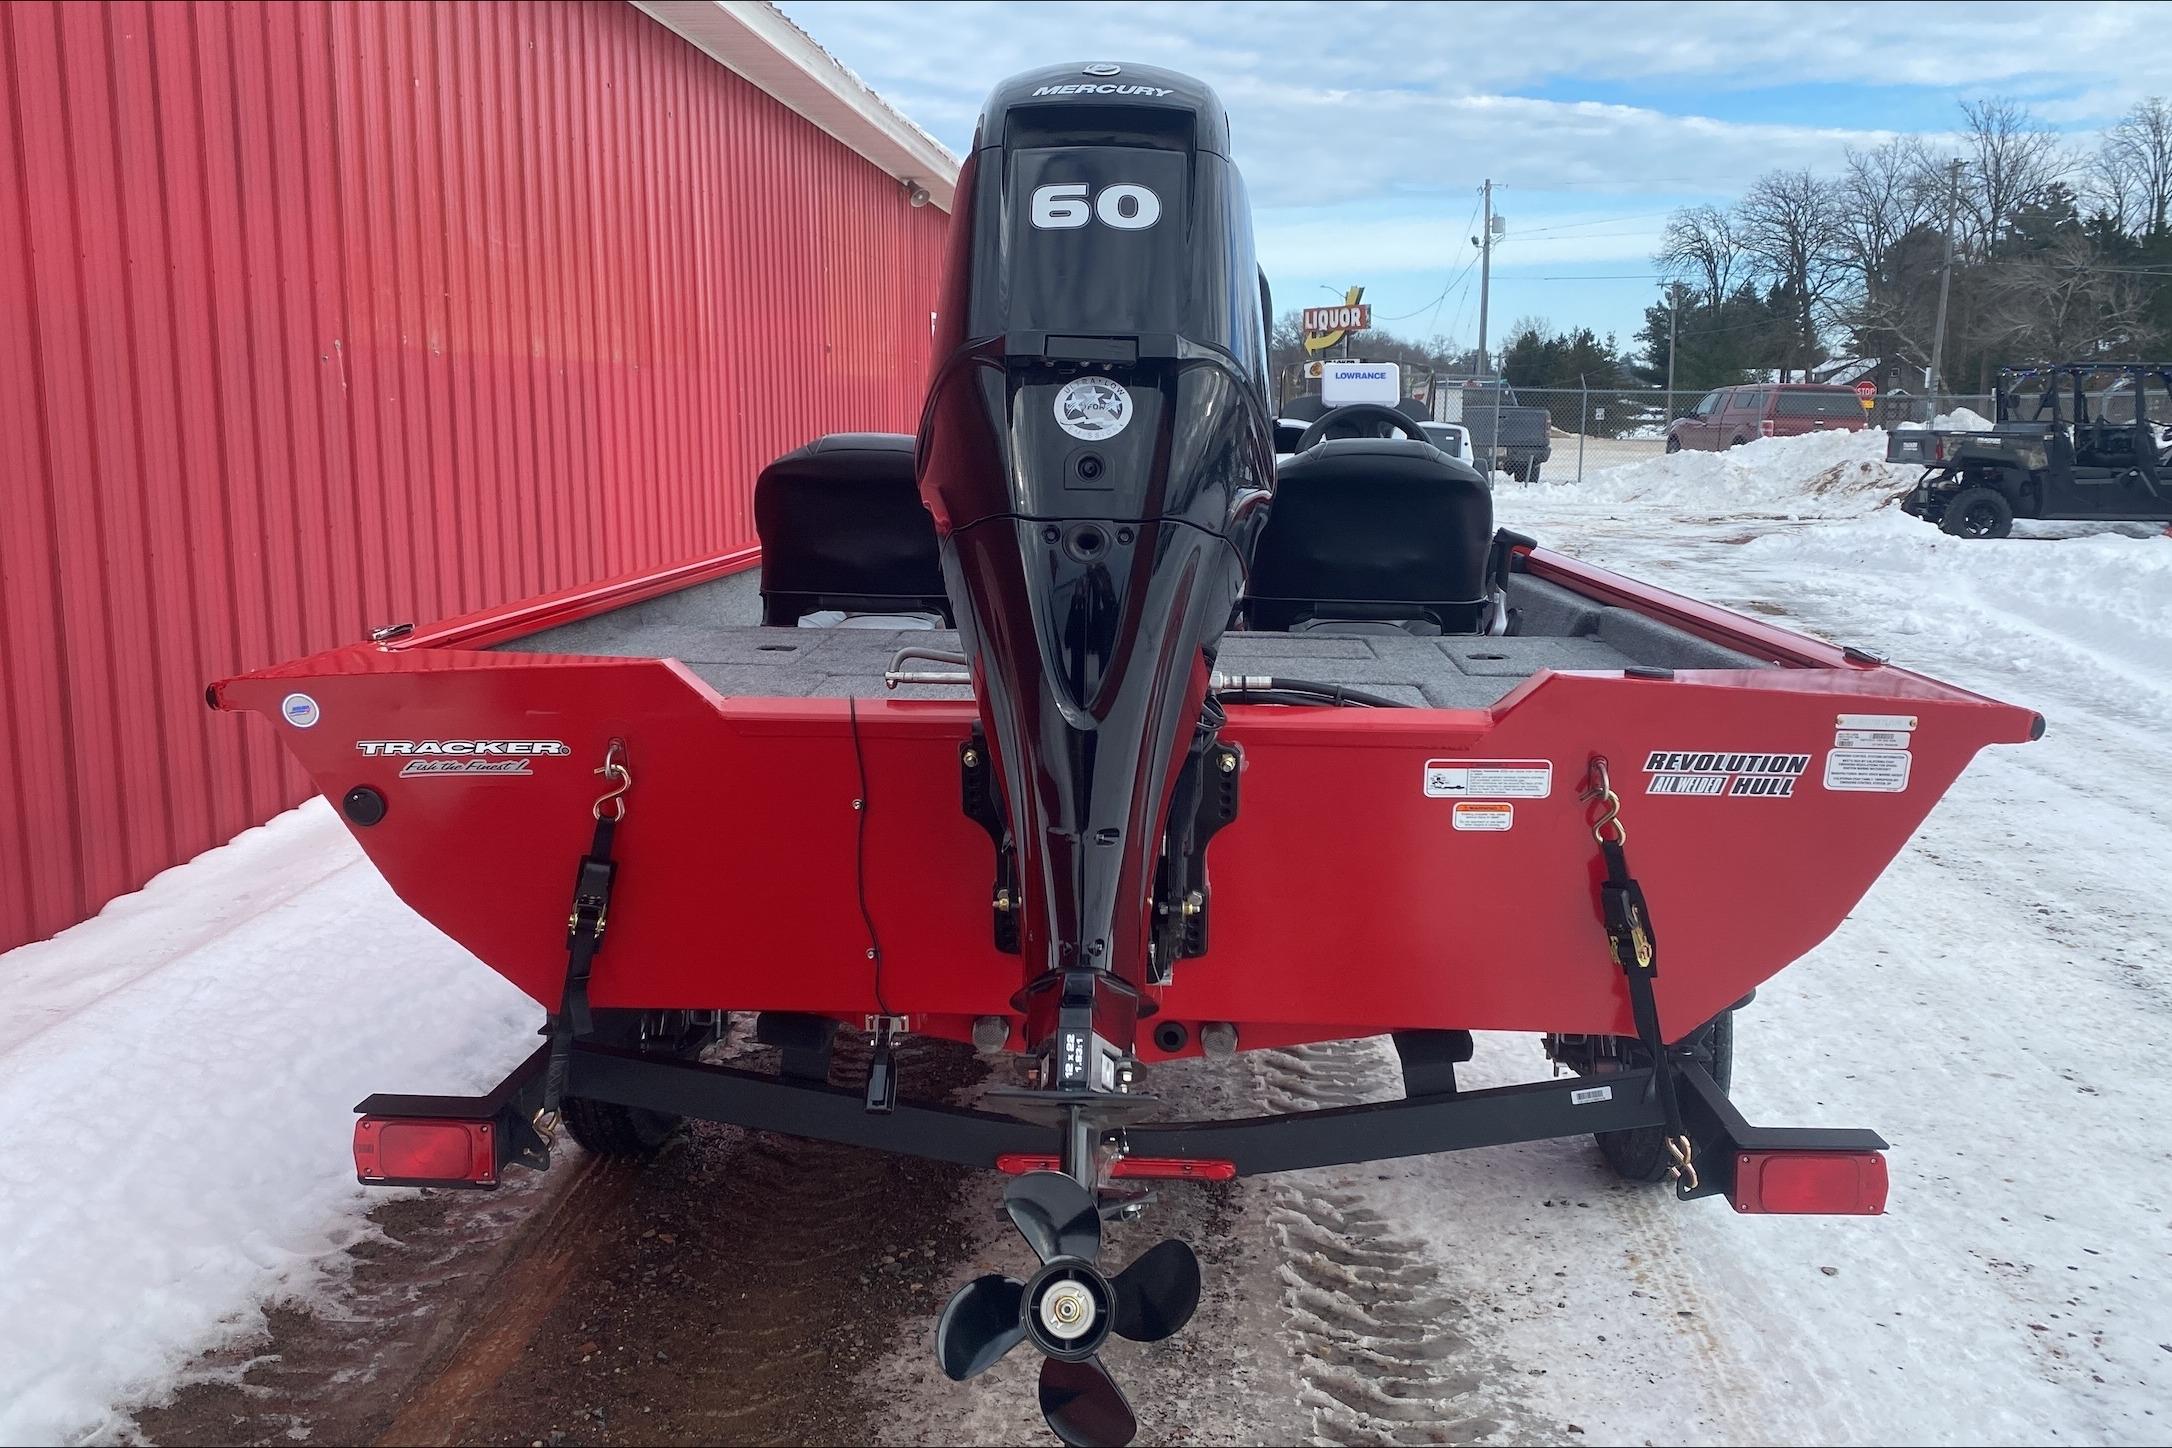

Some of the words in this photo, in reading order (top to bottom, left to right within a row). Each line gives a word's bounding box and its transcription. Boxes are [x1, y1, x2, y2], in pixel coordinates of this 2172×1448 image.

[1032, 84, 1174, 97] MERCURY
[1030, 183, 1162, 230] 60
[1305, 308, 1361, 331] LIQUOR
[1335, 372, 1387, 380] LOWRANCE
[1104, 380, 1126, 396] LOW
[1857, 387, 1876, 396] STOP
[358, 741, 563, 755] TRACKER
[406, 760, 439, 771] Fish
[440, 760, 463, 770] the
[1645, 752, 1809, 774] REVOLUTION
[1653, 776, 1672, 793] ALL
[1676, 776, 1723, 793] WELDED
[1731, 777, 1795, 795] HULL
[1065, 1063, 1073, 1079] 12
